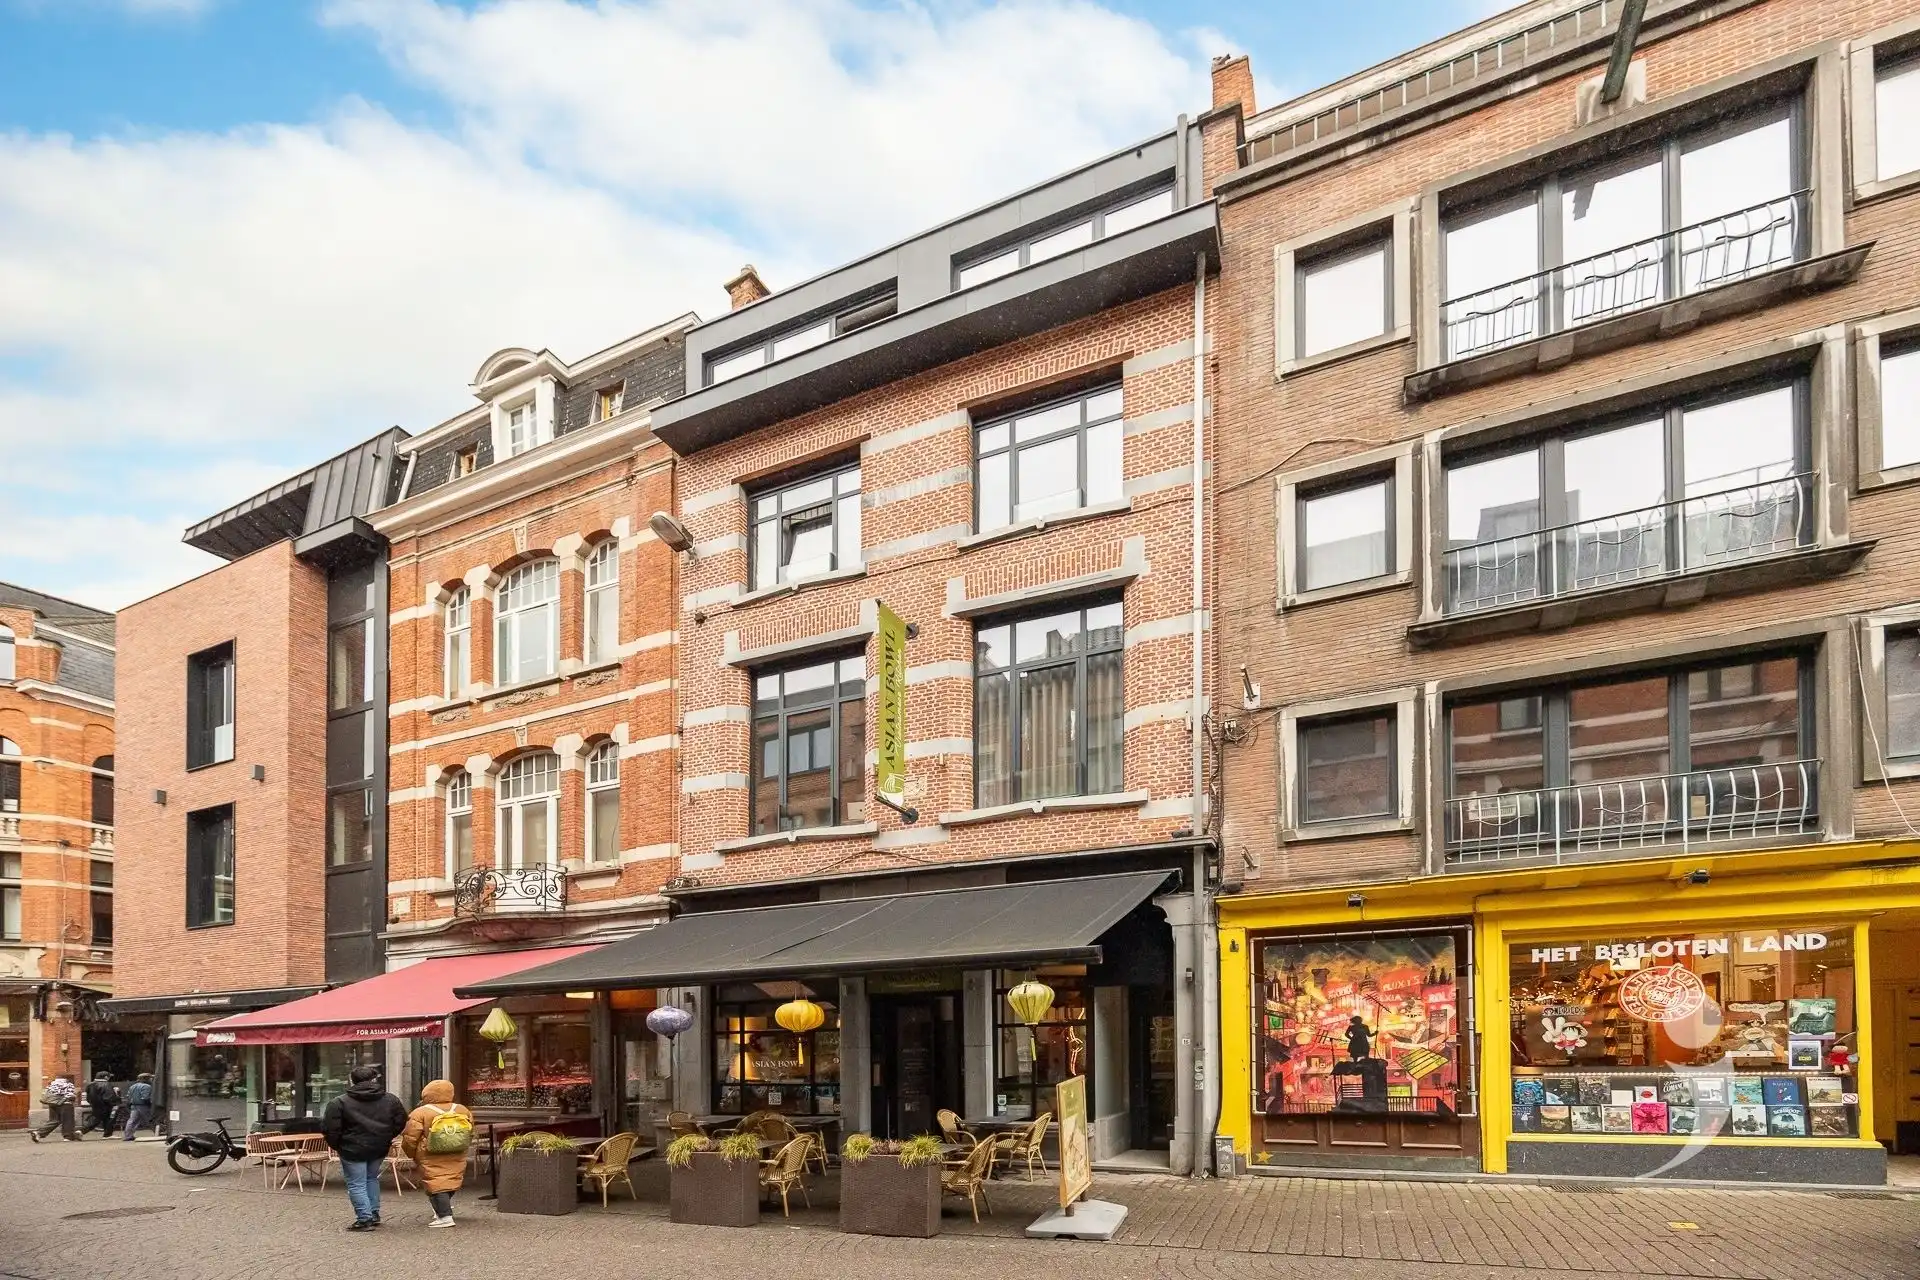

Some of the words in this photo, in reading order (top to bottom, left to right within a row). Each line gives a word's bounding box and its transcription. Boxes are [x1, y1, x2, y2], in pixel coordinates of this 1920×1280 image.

[885, 629, 896, 696] BOWL
[885, 699, 895, 770] ASIAN
[1531, 946, 1581, 963] HET
[1595, 940, 1728, 959] BESLOTEN
[1743, 933, 1828, 953] LAND
[777, 1060, 804, 1068] BOW
